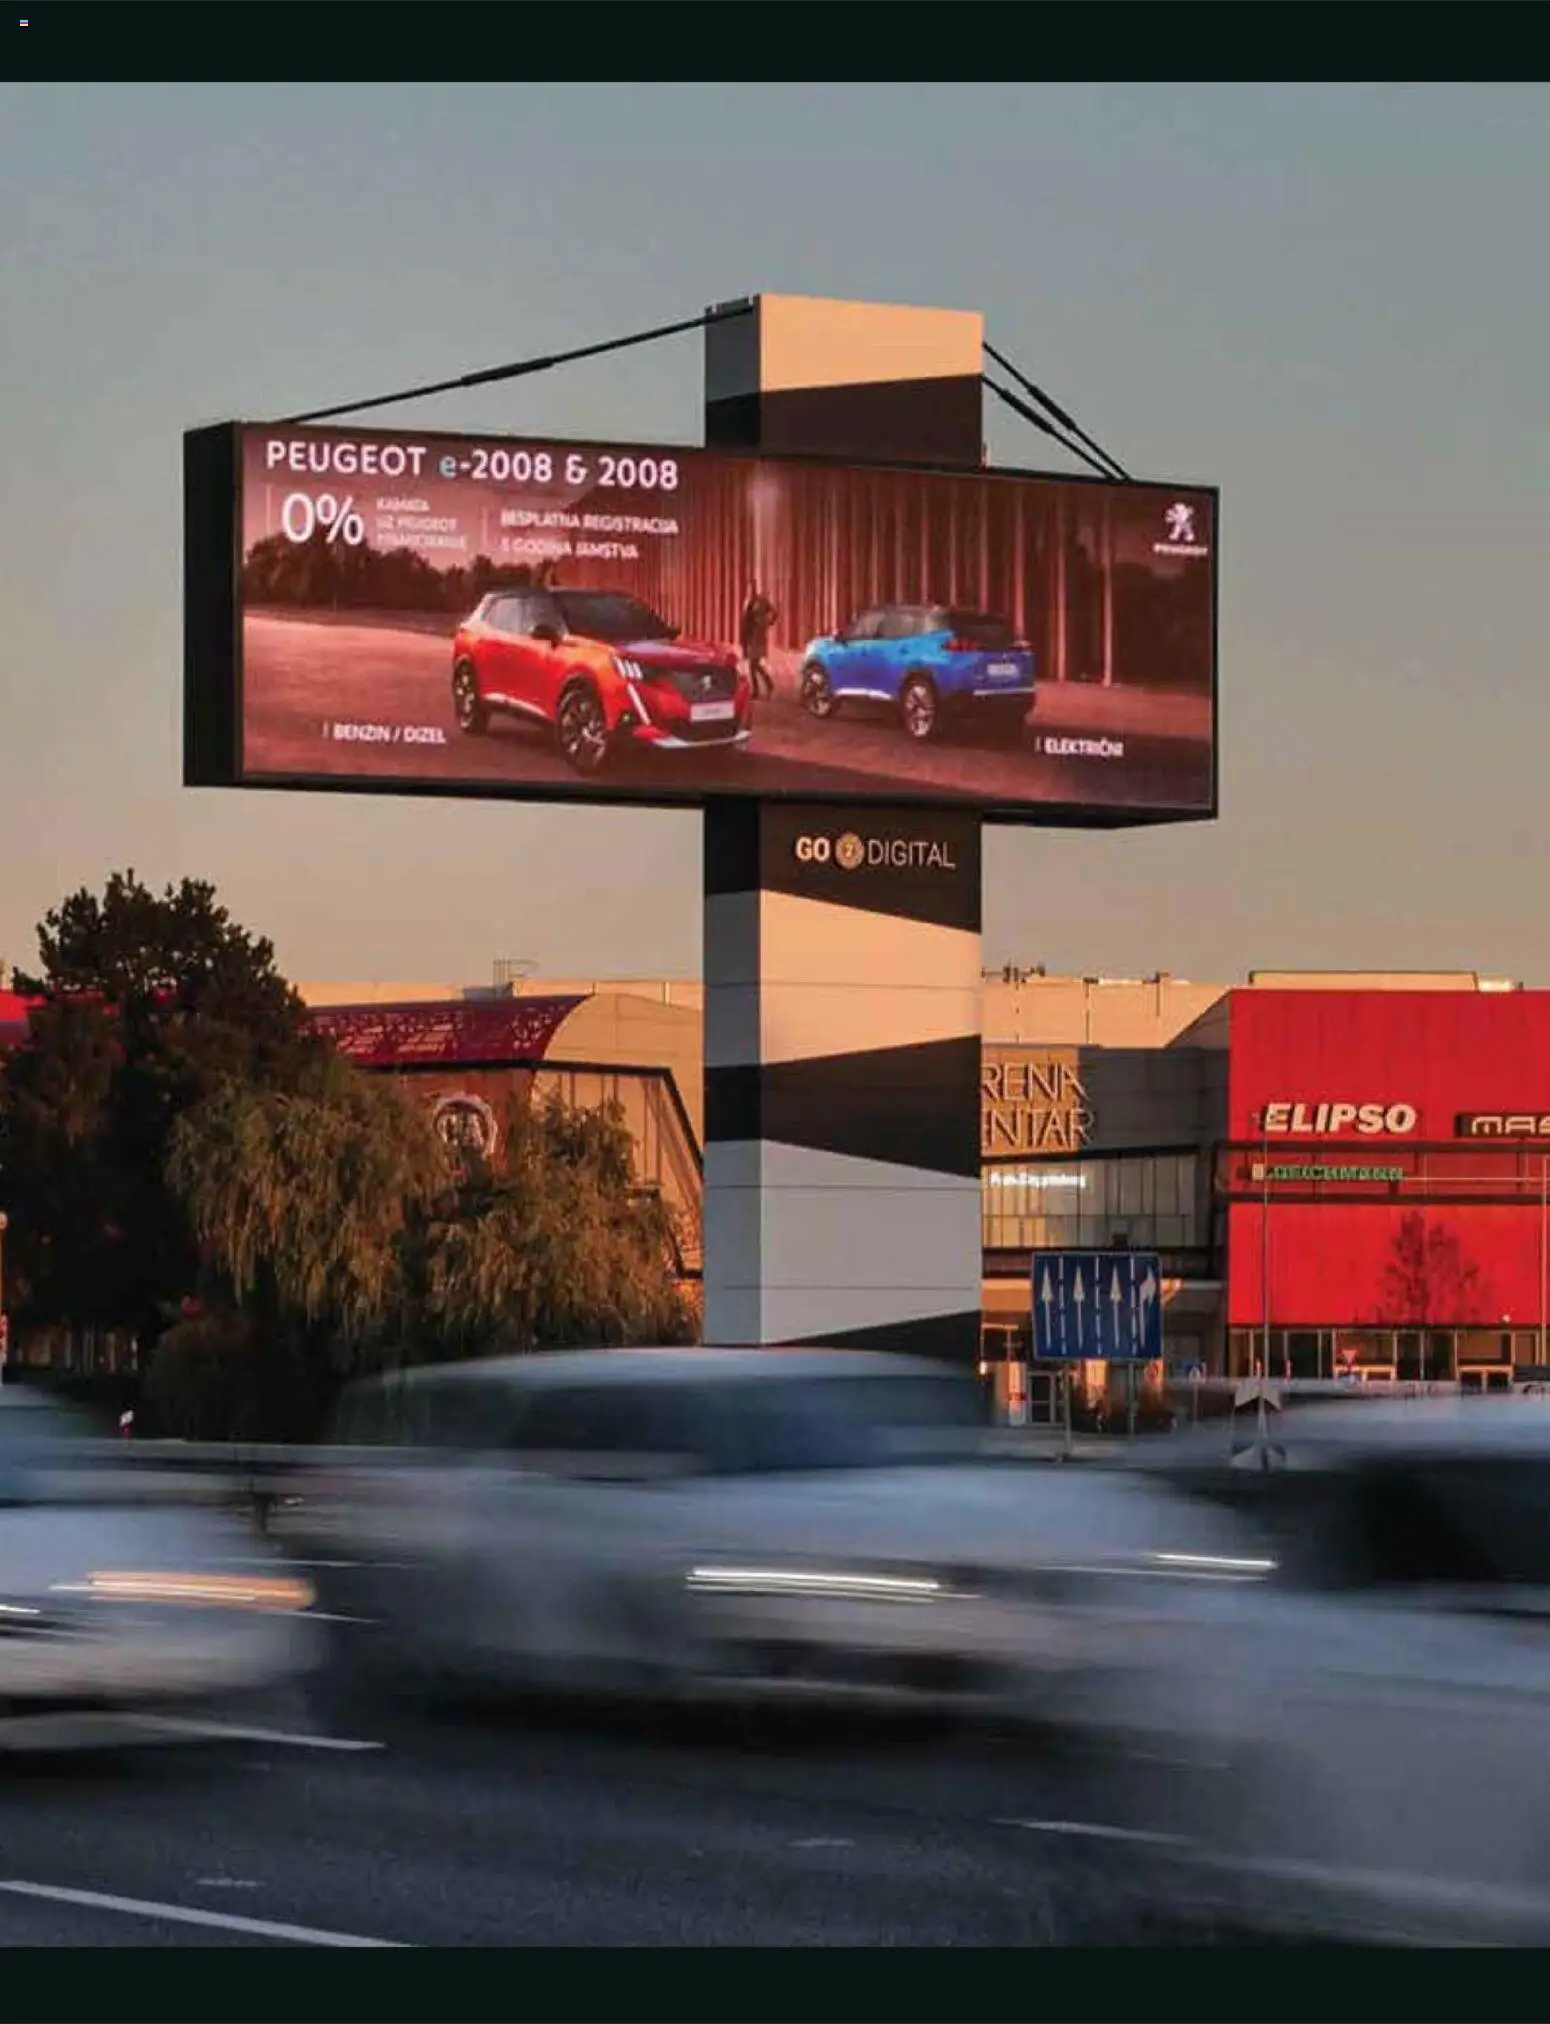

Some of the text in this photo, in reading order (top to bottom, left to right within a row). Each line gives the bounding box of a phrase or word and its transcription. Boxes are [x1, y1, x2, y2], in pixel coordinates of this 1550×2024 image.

[266, 440, 679, 490] PEUGEOT e-2008 & 2008
[282, 492, 364, 545] 0%
[795, 836, 830, 862] GO
[867, 839, 956, 870] DIGITAL
[1264, 1102, 1418, 1135] ELIPSO
